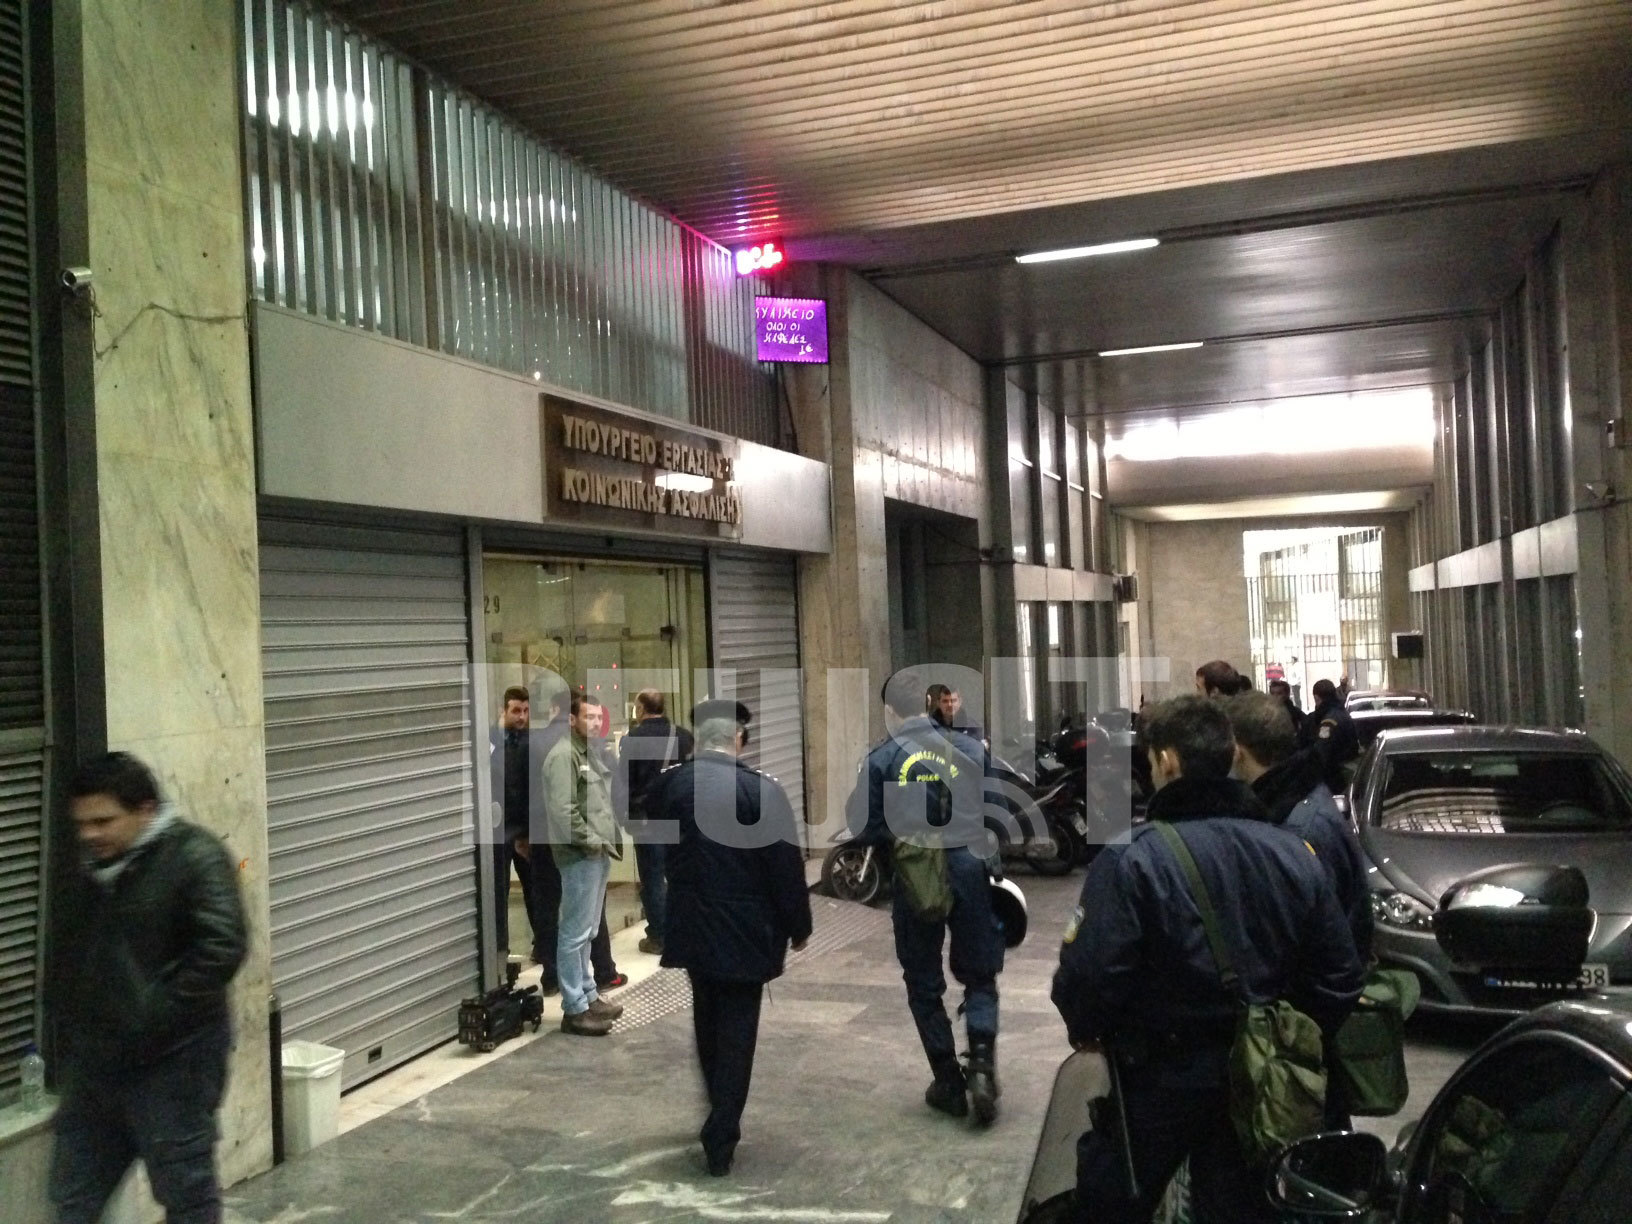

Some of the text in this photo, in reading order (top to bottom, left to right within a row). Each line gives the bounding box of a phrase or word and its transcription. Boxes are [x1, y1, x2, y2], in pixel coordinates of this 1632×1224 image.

[789, 322, 801, 331] ΟΙ
[562, 414, 658, 465] ΥΠΟΥΡΓΕΙΟ
[662, 439, 724, 480] ΕΡΓΑΣΙΑΣ
[563, 467, 667, 515] ΚΟΙΝΩΝΙΚΗΣ
[484, 595, 500, 614] 29
